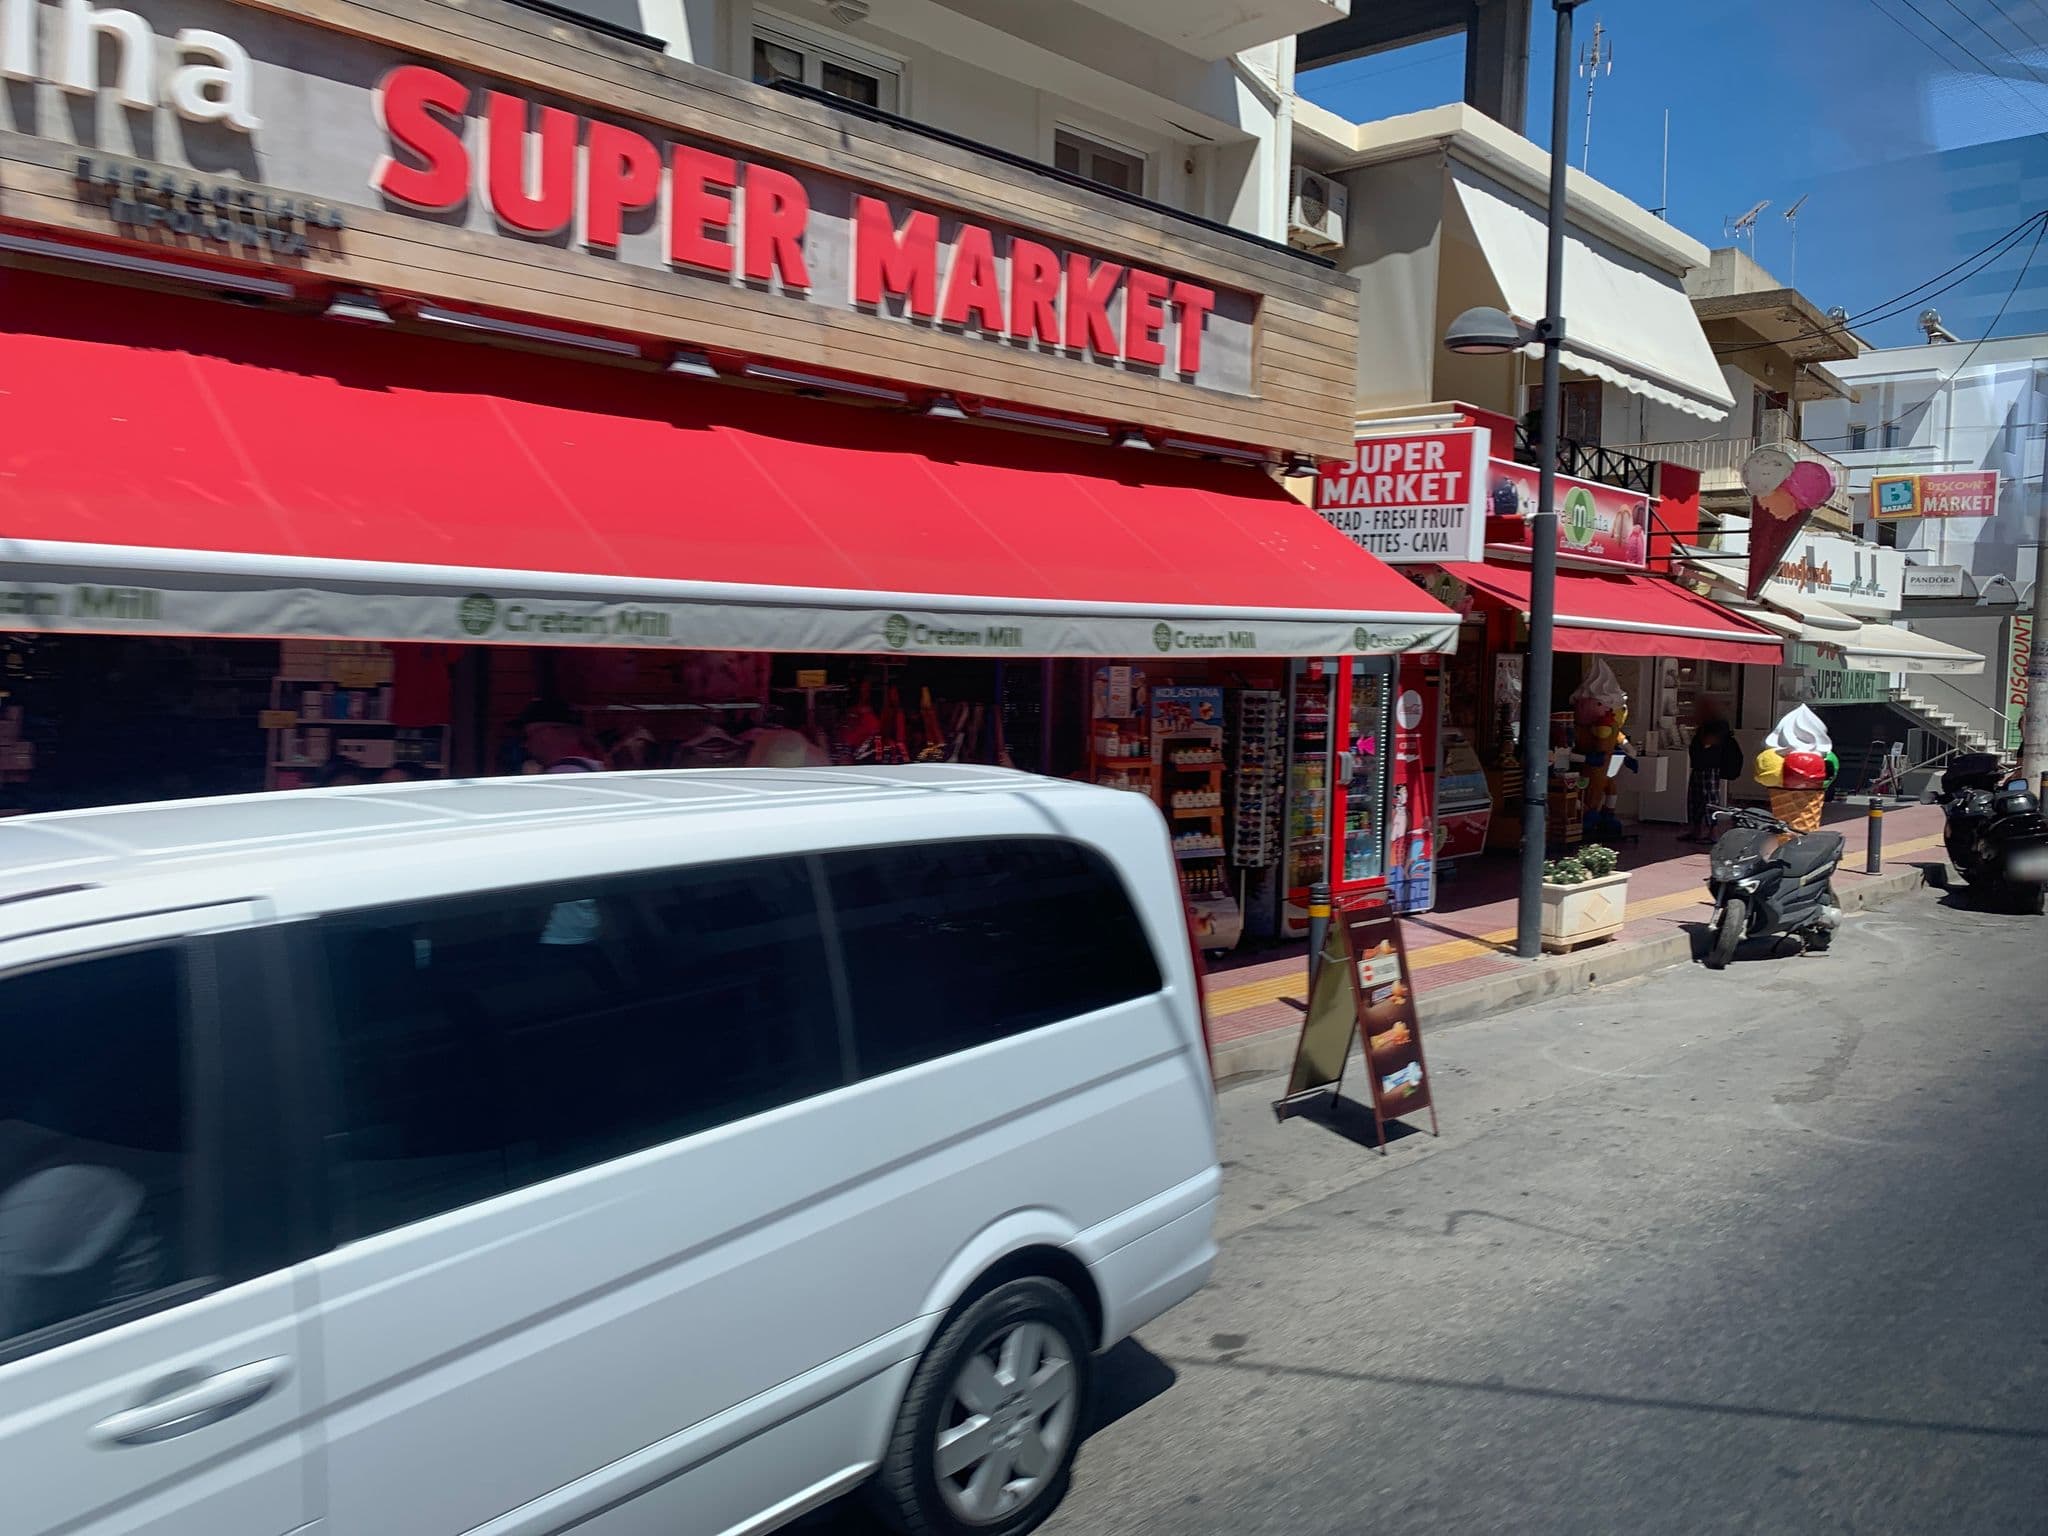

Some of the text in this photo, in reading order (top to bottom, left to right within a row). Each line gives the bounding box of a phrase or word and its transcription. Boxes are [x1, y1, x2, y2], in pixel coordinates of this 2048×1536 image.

[378, 66, 1216, 372] SUPER MARKET
[1339, 440, 1446, 476] SUPER
[1322, 471, 1462, 505] MARKET
[1923, 494, 1993, 513] MARKET
[1373, 510, 1417, 529] FRESH
[1420, 507, 1465, 528] FRUIT
[1412, 532, 1449, 552] CAVA
[1910, 576, 1956, 584] PANDORA
[504, 605, 608, 634] Cretan
[913, 624, 1023, 648] Cretan Mill
[1175, 630, 1256, 648] Cretan Mill
[2010, 616, 2031, 707] DISCOUNT
